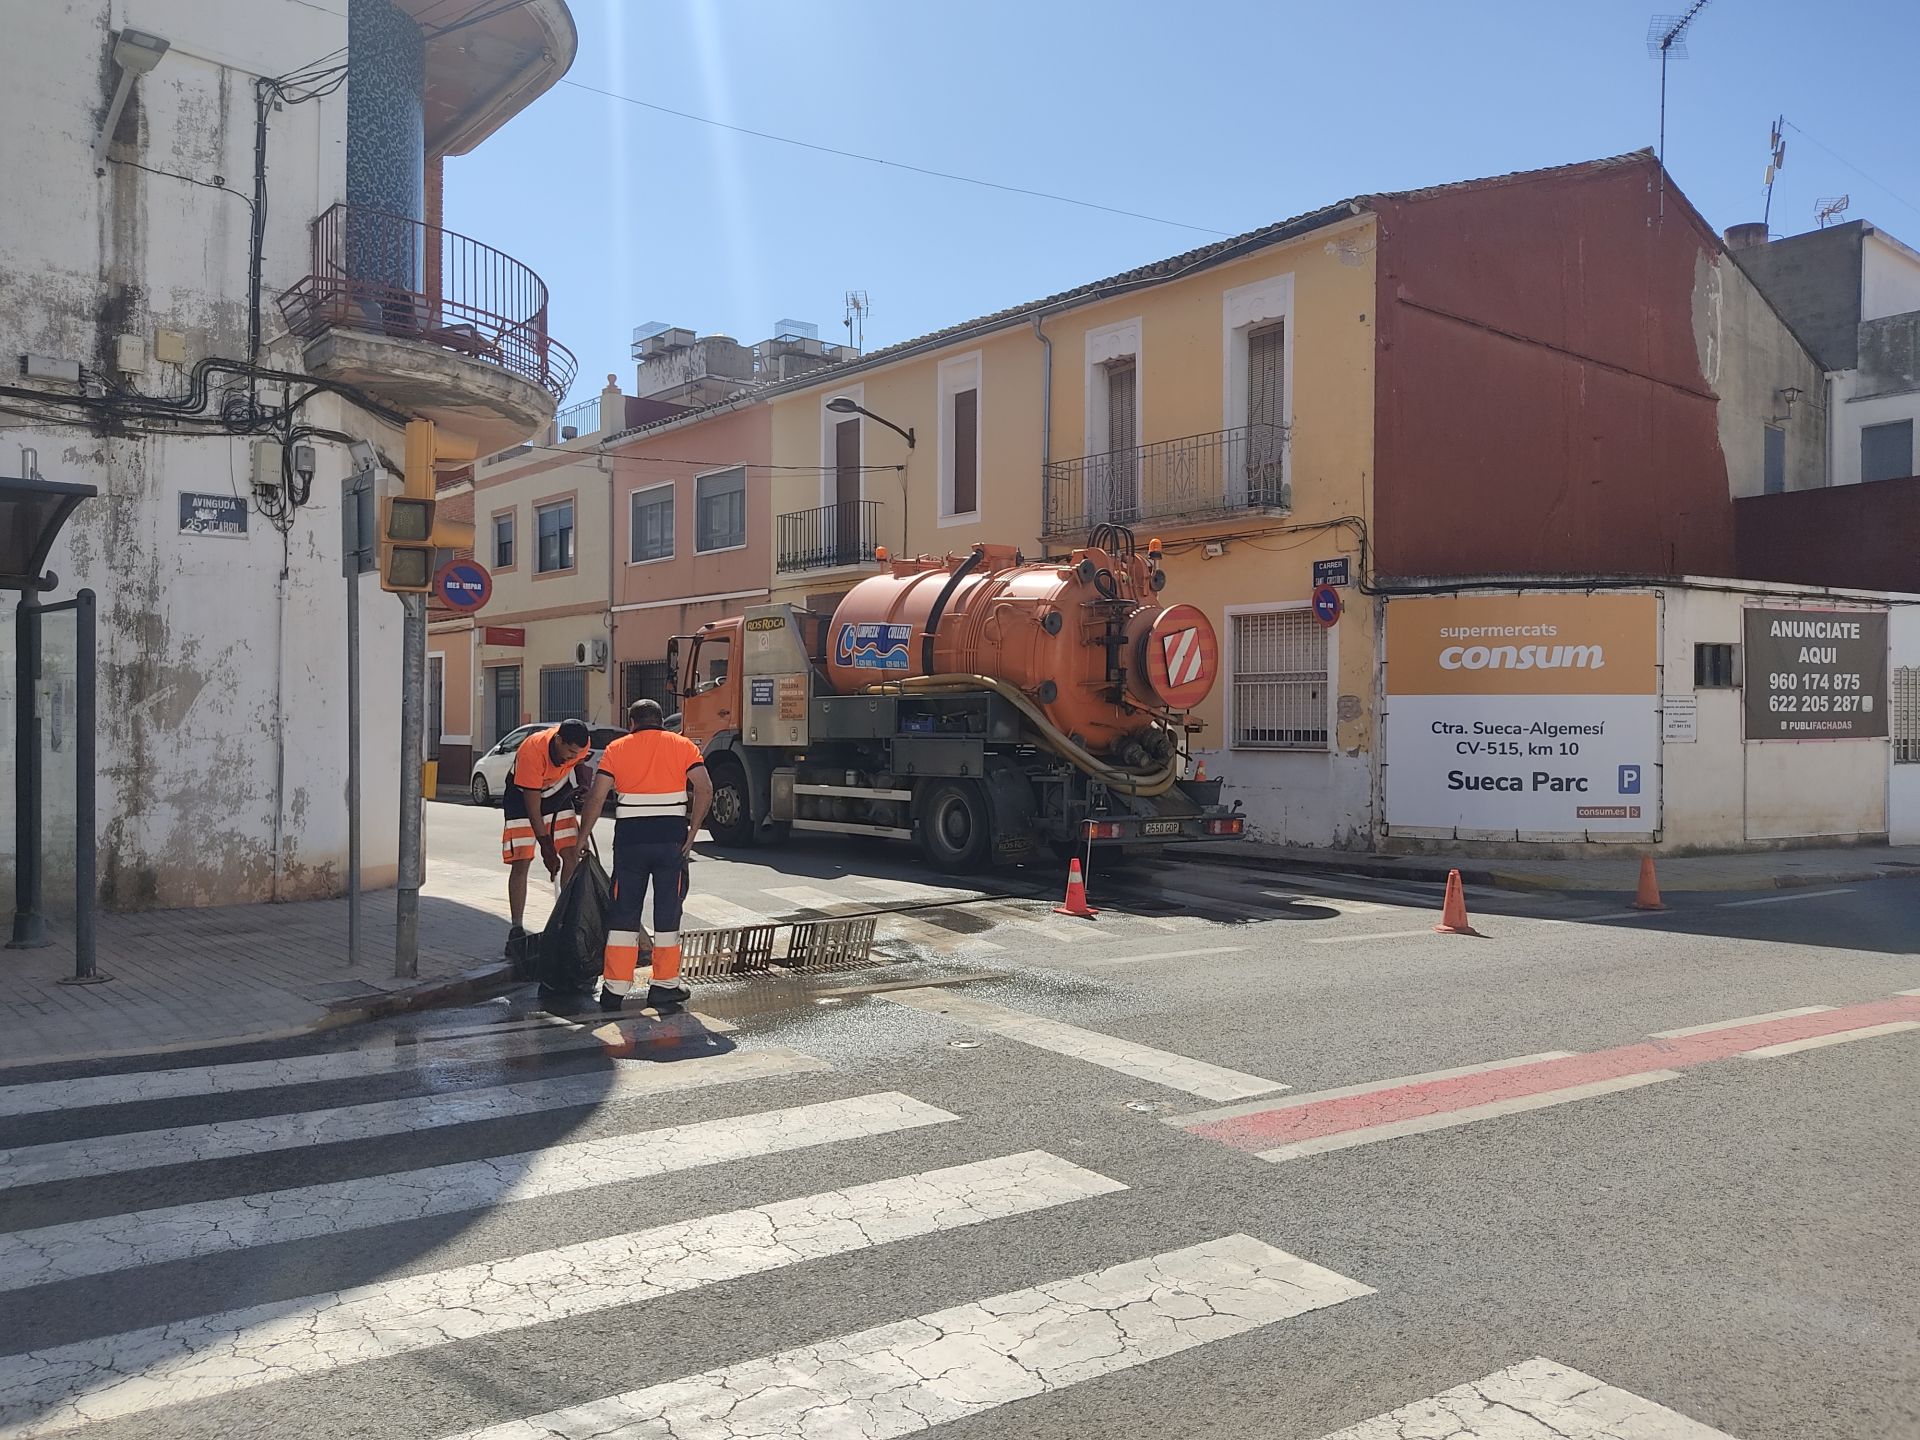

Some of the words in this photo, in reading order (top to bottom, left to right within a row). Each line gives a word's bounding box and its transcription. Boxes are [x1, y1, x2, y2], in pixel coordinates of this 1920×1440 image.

[192, 497, 236, 511] AVINGUDA
[185, 518, 202, 531] 25
[1319, 561, 1342, 570] CARRER
[1439, 623, 1557, 640] supermercats
[1770, 620, 1860, 639] ANUNCIATE
[1438, 645, 1605, 670] consum
[1798, 646, 1837, 664] AQUI
[1769, 672, 1798, 690] 960
[1802, 673, 1829, 690] 174
[1833, 673, 1860, 690] 875
[1769, 695, 1797, 712] 622
[1801, 695, 1829, 712] 205
[1833, 695, 1860, 712] 287
[1431, 721, 1468, 735] Ctra.
[1473, 721, 1605, 738] Sueca-Algemesí
[1789, 720, 1852, 730] PUBLIFACHADAS
[1456, 741, 1523, 757] CV-515,
[1528, 742, 1553, 756] km
[1559, 742, 1579, 756] 10
[1448, 770, 1523, 791] Sueca
[1532, 771, 1588, 792] Parc
[1623, 769, 1637, 788] P
[1579, 807, 1625, 816] consum.es
